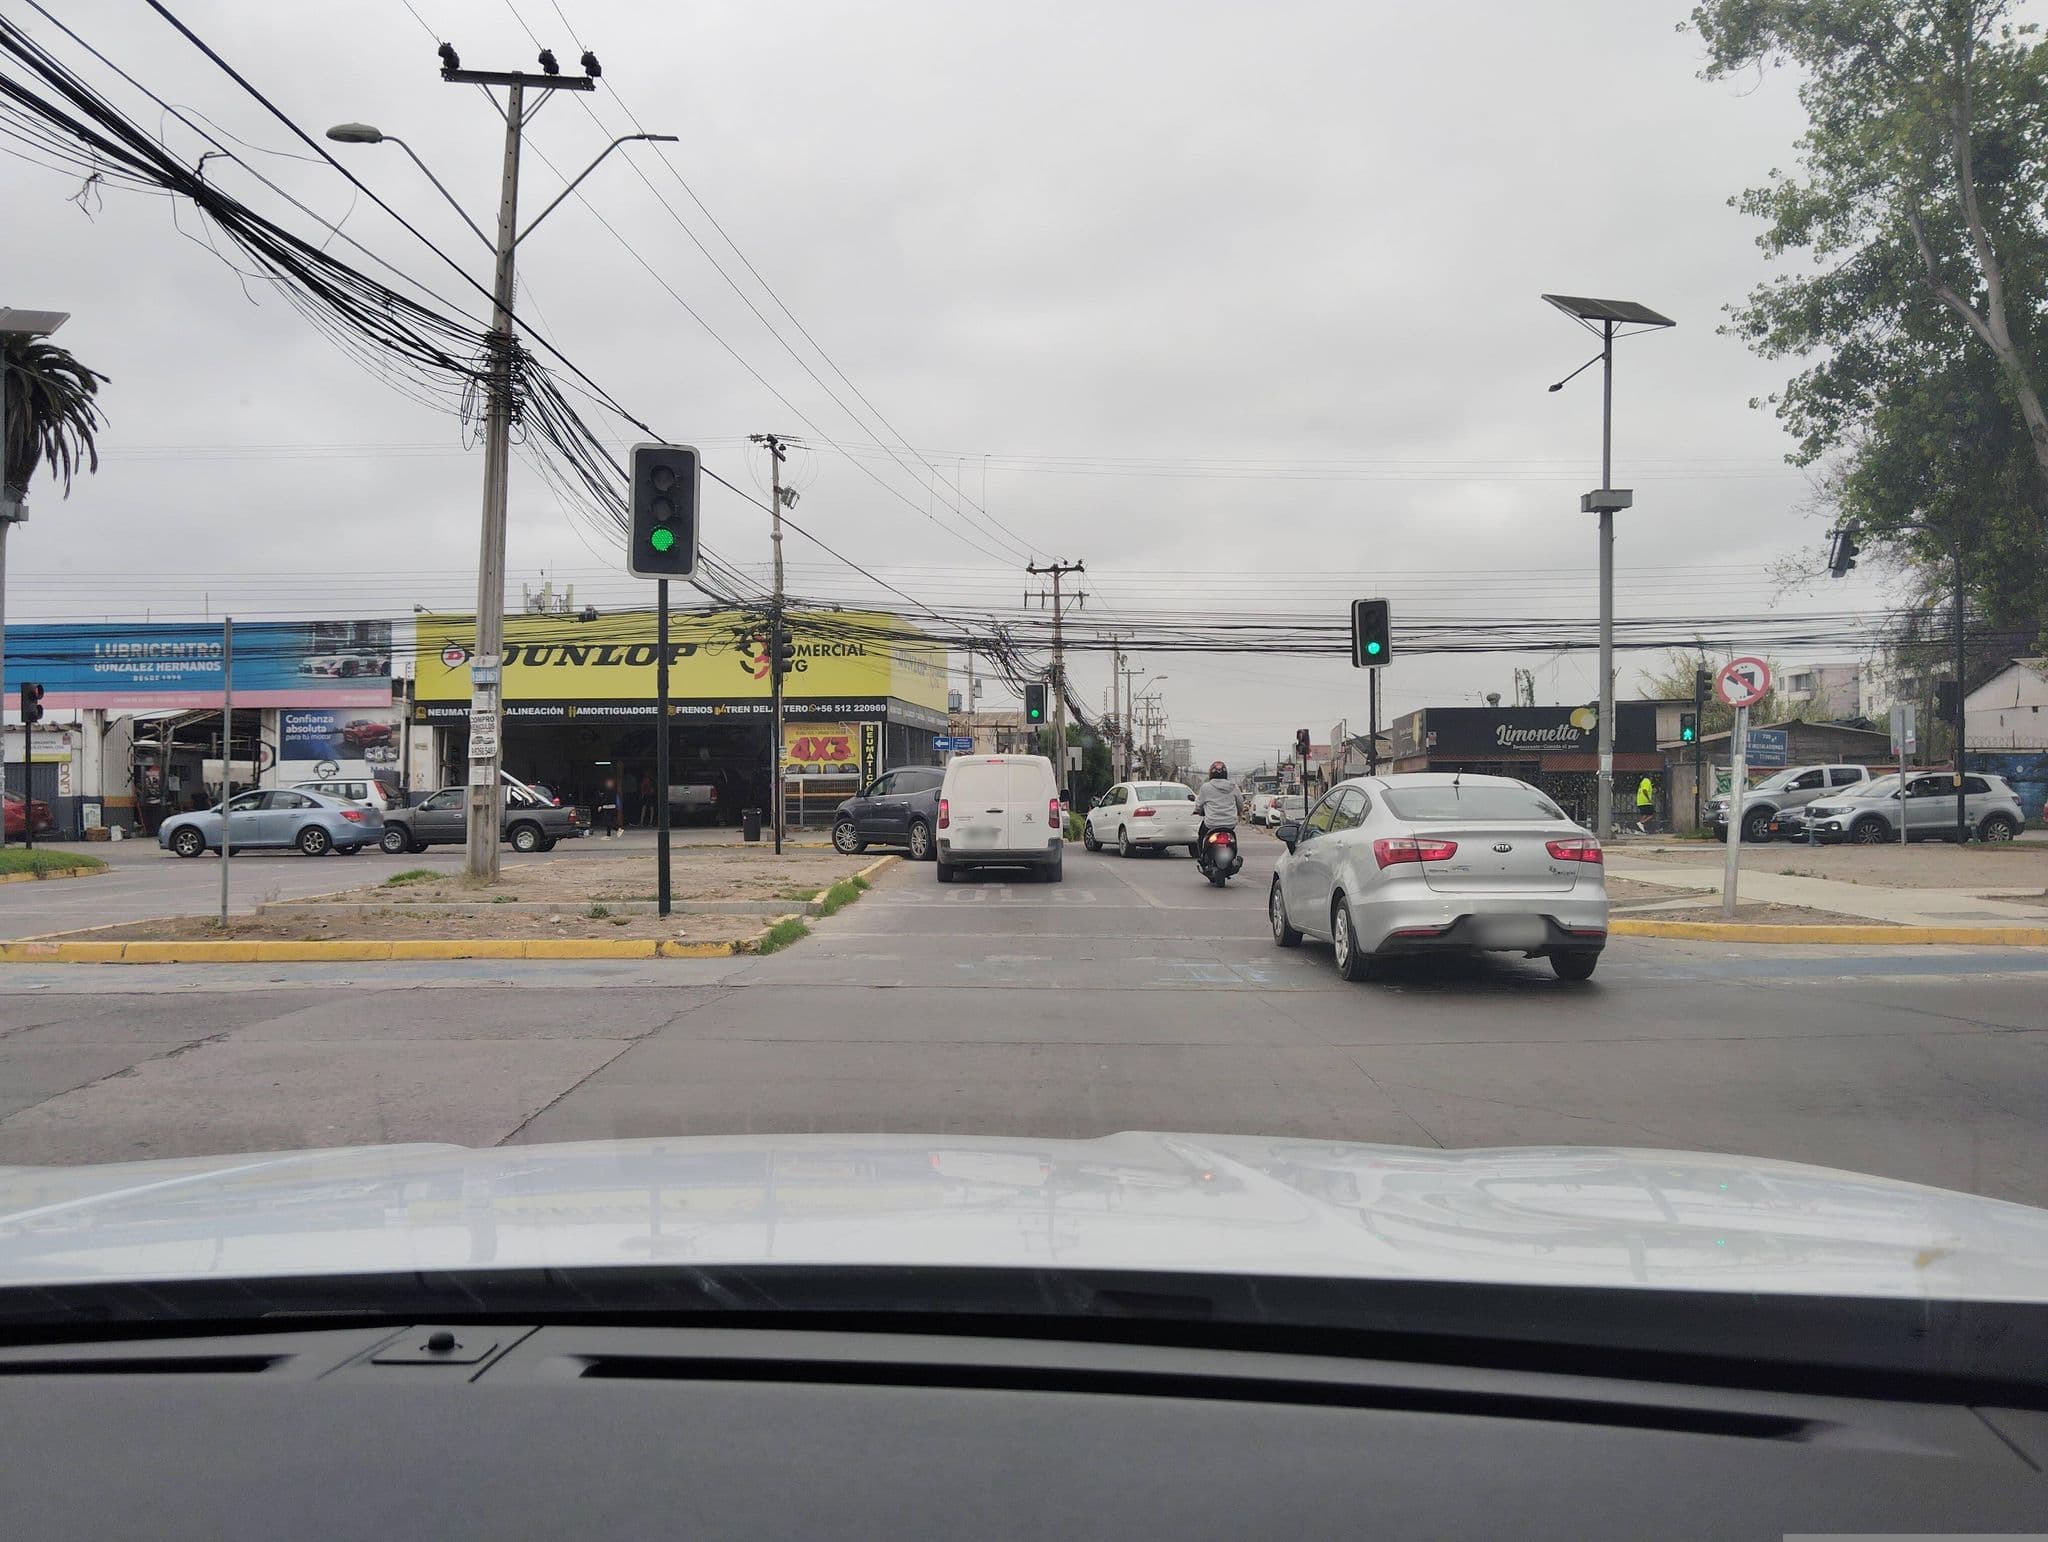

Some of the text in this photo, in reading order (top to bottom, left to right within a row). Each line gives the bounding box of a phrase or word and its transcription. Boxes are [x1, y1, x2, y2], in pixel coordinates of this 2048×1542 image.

[95, 643, 222, 657] LUBRICENTRO
[157, 661, 222, 672] HERMANOS
[427, 708, 470, 716] NEUMAT
[506, 706, 564, 715] ALINEACIÓN
[576, 706, 658, 715] AMORTIGUADORE
[676, 706, 713, 714] FRENOS
[726, 705, 750, 714] TREN
[835, 704, 851, 712] 512
[854, 704, 886, 712] 220969
[286, 715, 334, 723] Confianza
[286, 725, 326, 733] absoluta
[286, 734, 301, 742] para
[1496, 724, 1580, 745] Limonetta
